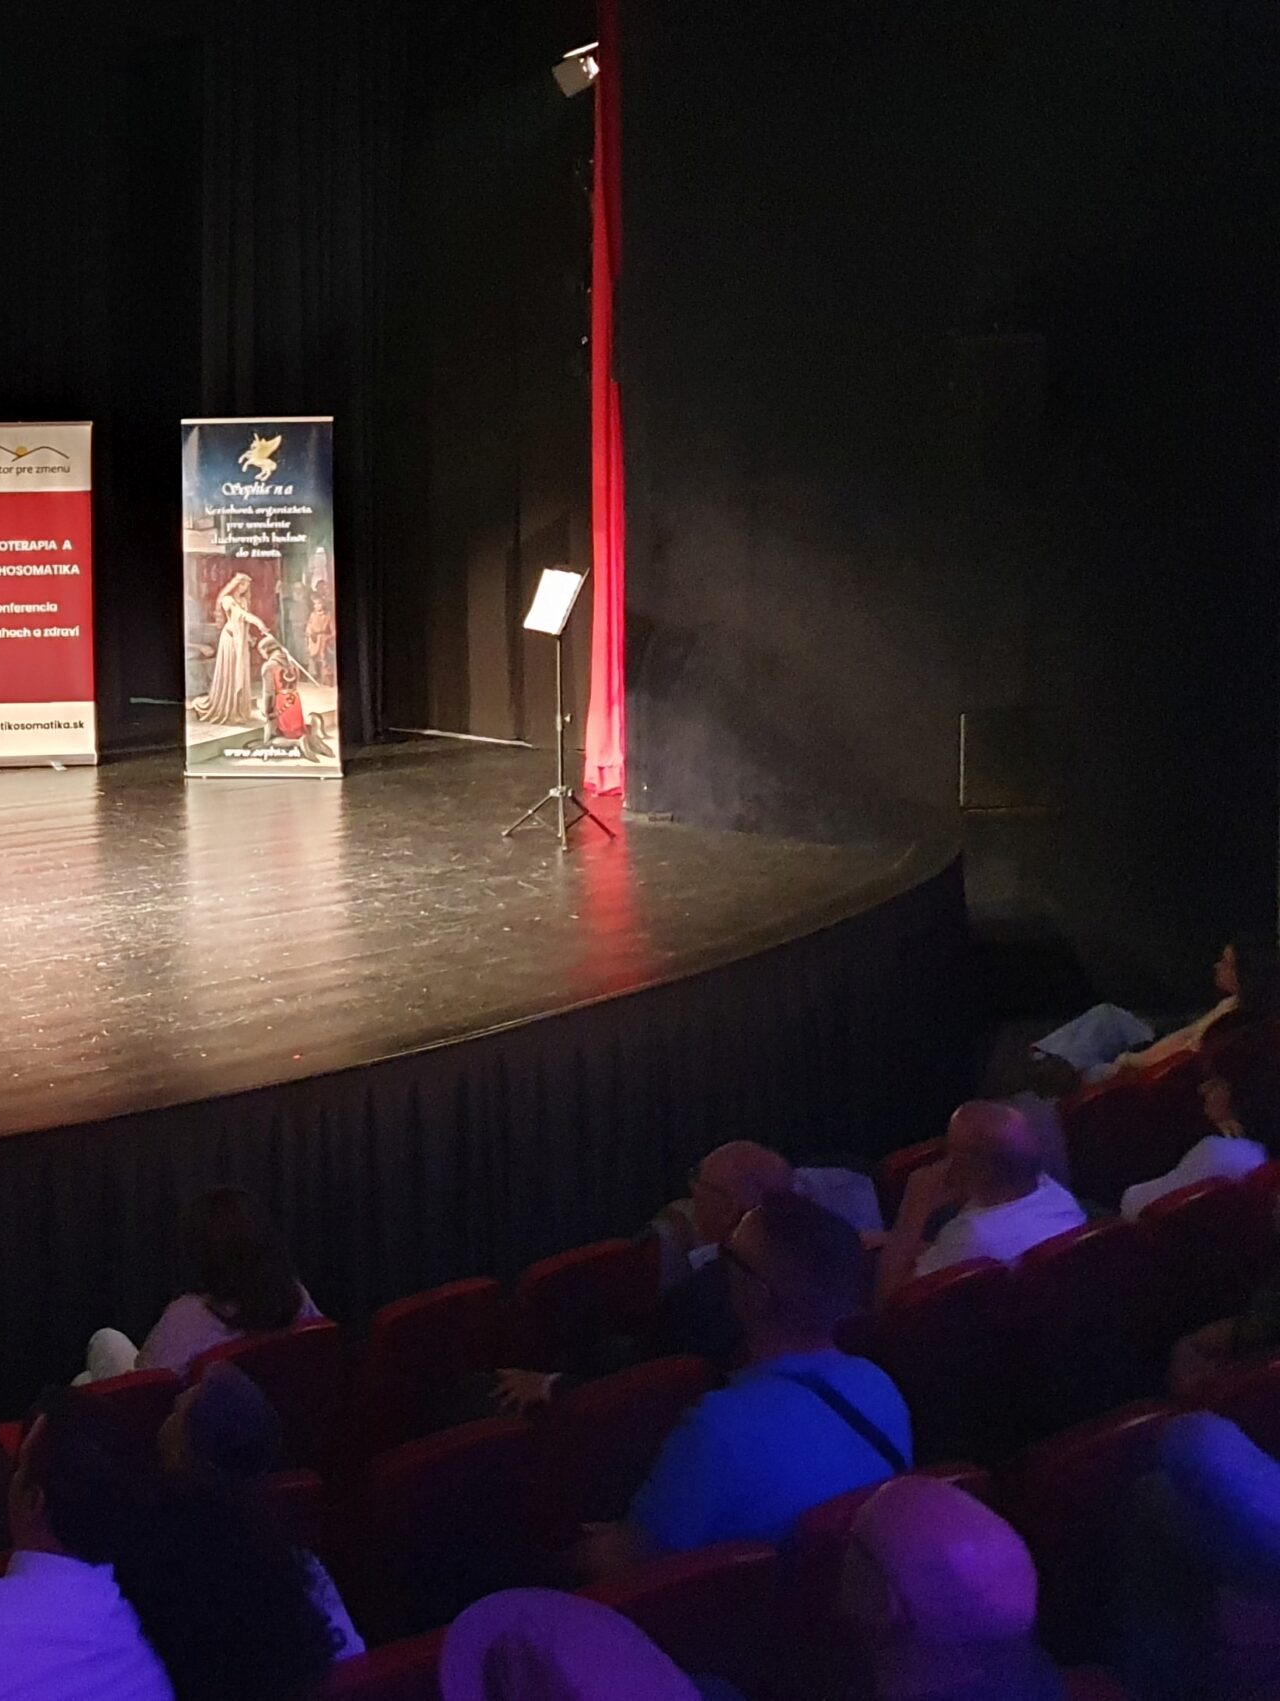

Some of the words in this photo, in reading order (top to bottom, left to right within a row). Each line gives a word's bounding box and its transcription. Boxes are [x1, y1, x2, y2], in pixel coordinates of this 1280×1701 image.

[16, 465, 33, 476] pre
[35, 464, 71, 474] zmenu
[62, 539, 73, 551] A
[32, 628, 42, 638] a
[43, 625, 80, 637] zdraví
